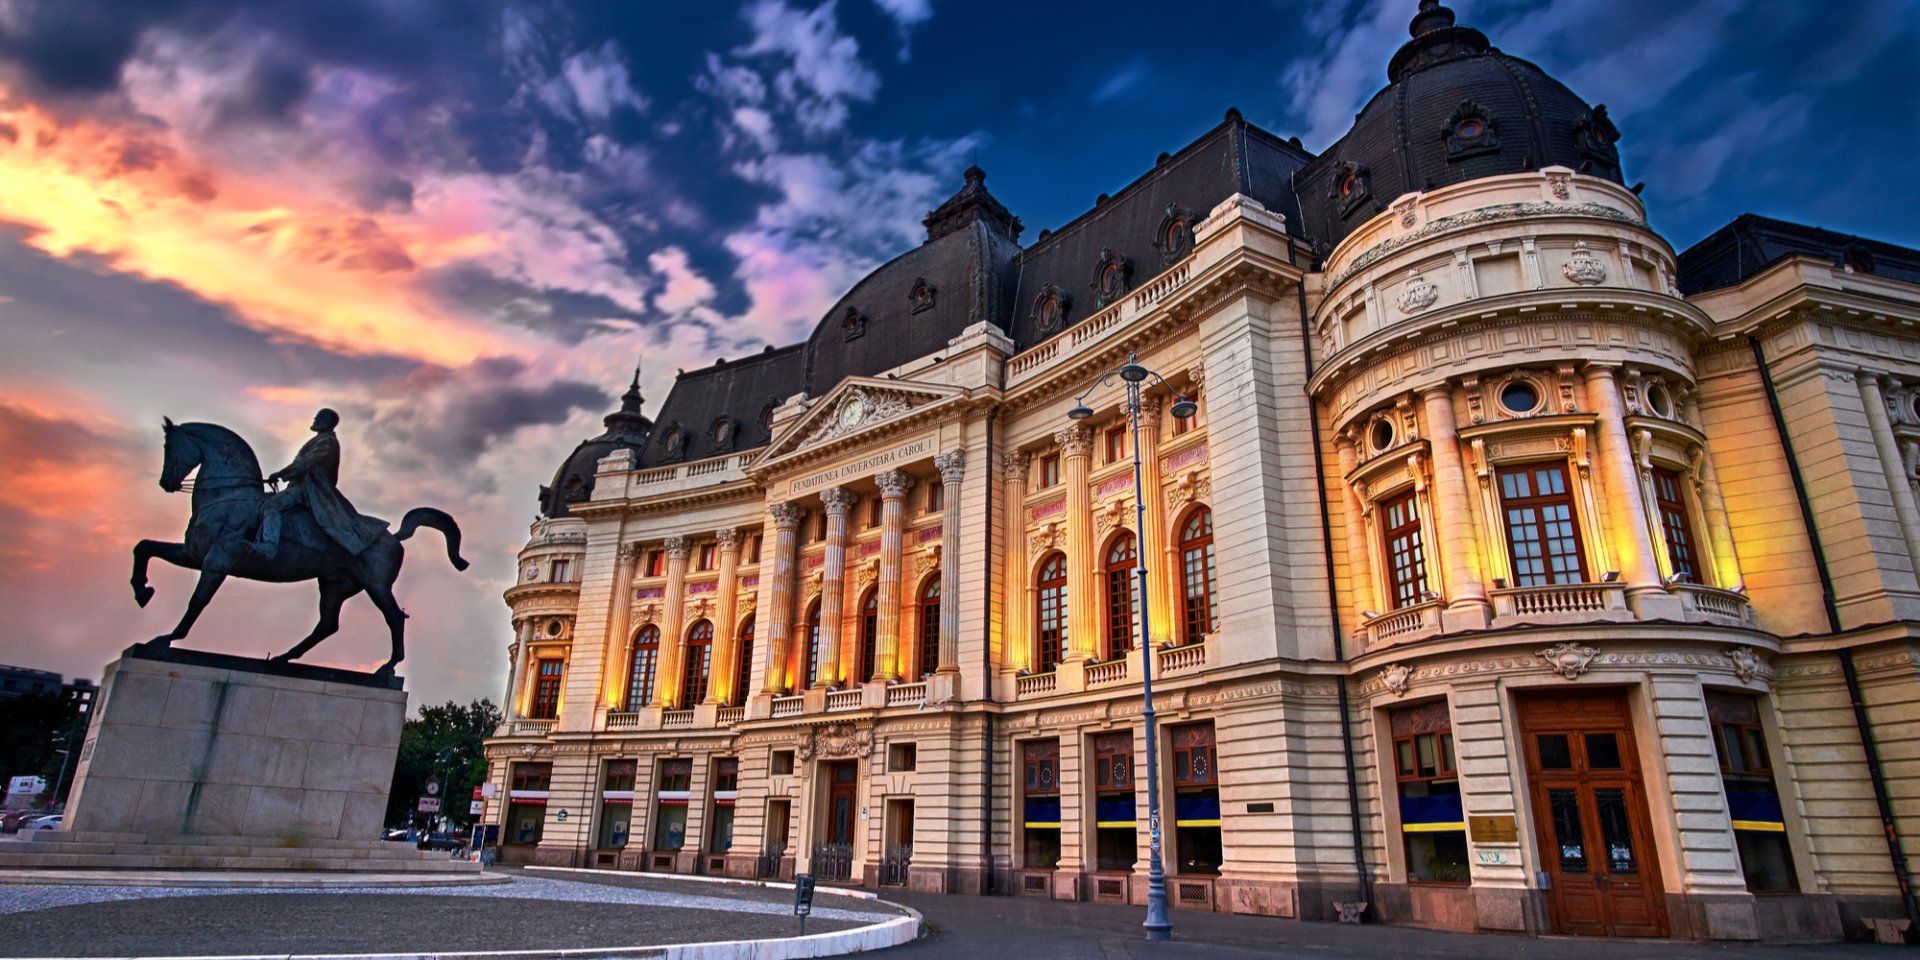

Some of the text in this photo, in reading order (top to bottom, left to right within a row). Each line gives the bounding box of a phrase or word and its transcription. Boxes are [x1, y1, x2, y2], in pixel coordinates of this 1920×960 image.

[841, 452, 895, 477] UNIVERSITARA
[898, 441, 924, 459] CAROL
[928, 439, 932, 450] I
